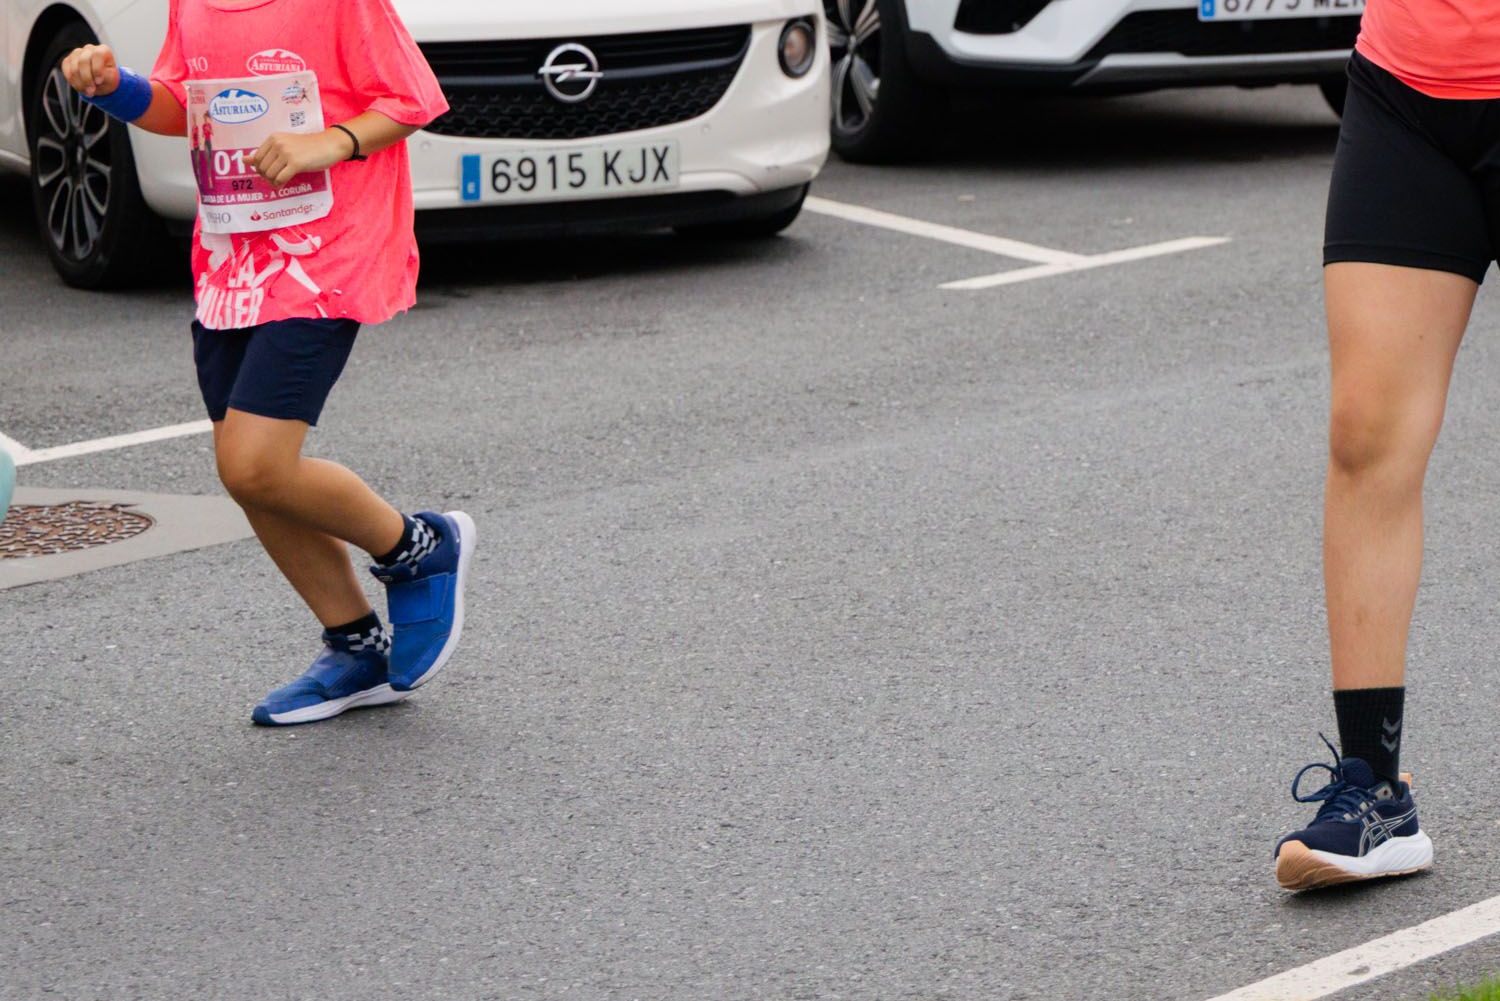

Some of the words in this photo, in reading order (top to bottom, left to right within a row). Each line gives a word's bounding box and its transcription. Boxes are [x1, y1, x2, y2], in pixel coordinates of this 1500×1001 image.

[212, 103, 264, 115] ASTURIANA
[214, 150, 257, 175] 01
[491, 153, 586, 193] 6915
[604, 146, 670, 186] KJX
[226, 195, 236, 203] LA
[279, 184, 312, 197] CORUÑA
[232, 179, 253, 191] 972
[263, 204, 313, 221] Santander
